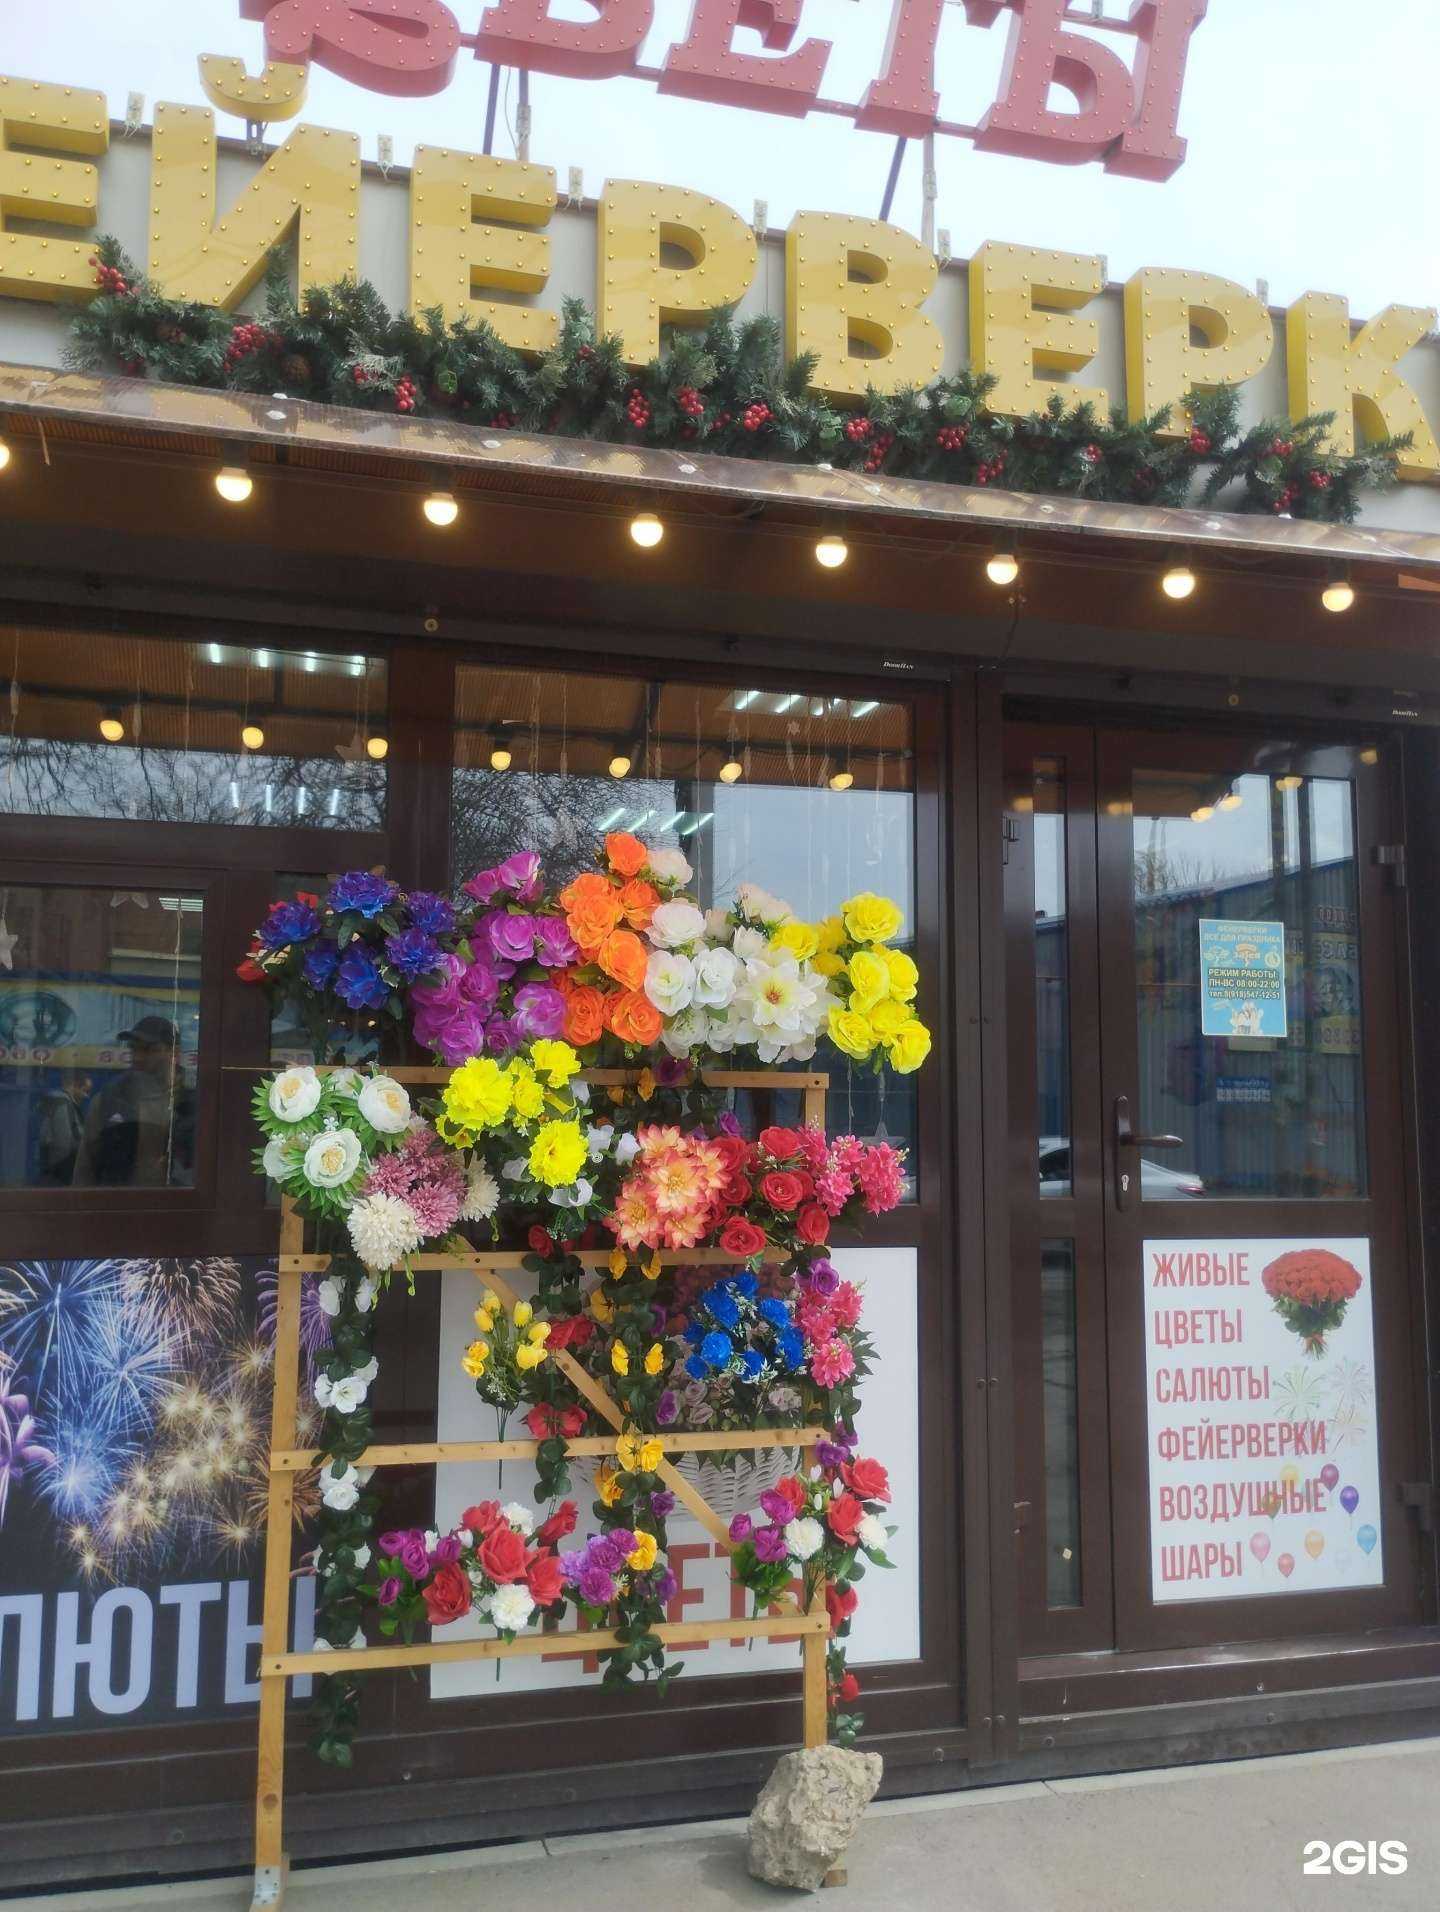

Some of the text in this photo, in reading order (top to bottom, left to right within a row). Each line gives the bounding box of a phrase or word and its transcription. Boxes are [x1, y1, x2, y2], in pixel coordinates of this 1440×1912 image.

[1208, 968, 1239, 977] РЕЖИМ
[1208, 978, 1280, 989] ПН-ВС 08:00-22:00
[1152, 1252, 1250, 1288] ЖИВЫЕ
[1154, 1308, 1242, 1349] ЦВЕТЫ
[1155, 1365, 1270, 1403] САЛЮТЫ
[1157, 1417, 1327, 1462] ФЕЙЕРВЕРКИ
[1159, 1477, 1327, 1523] ВОЗДУШНЫЕ
[1161, 1541, 1242, 1582] ШАРЫ
